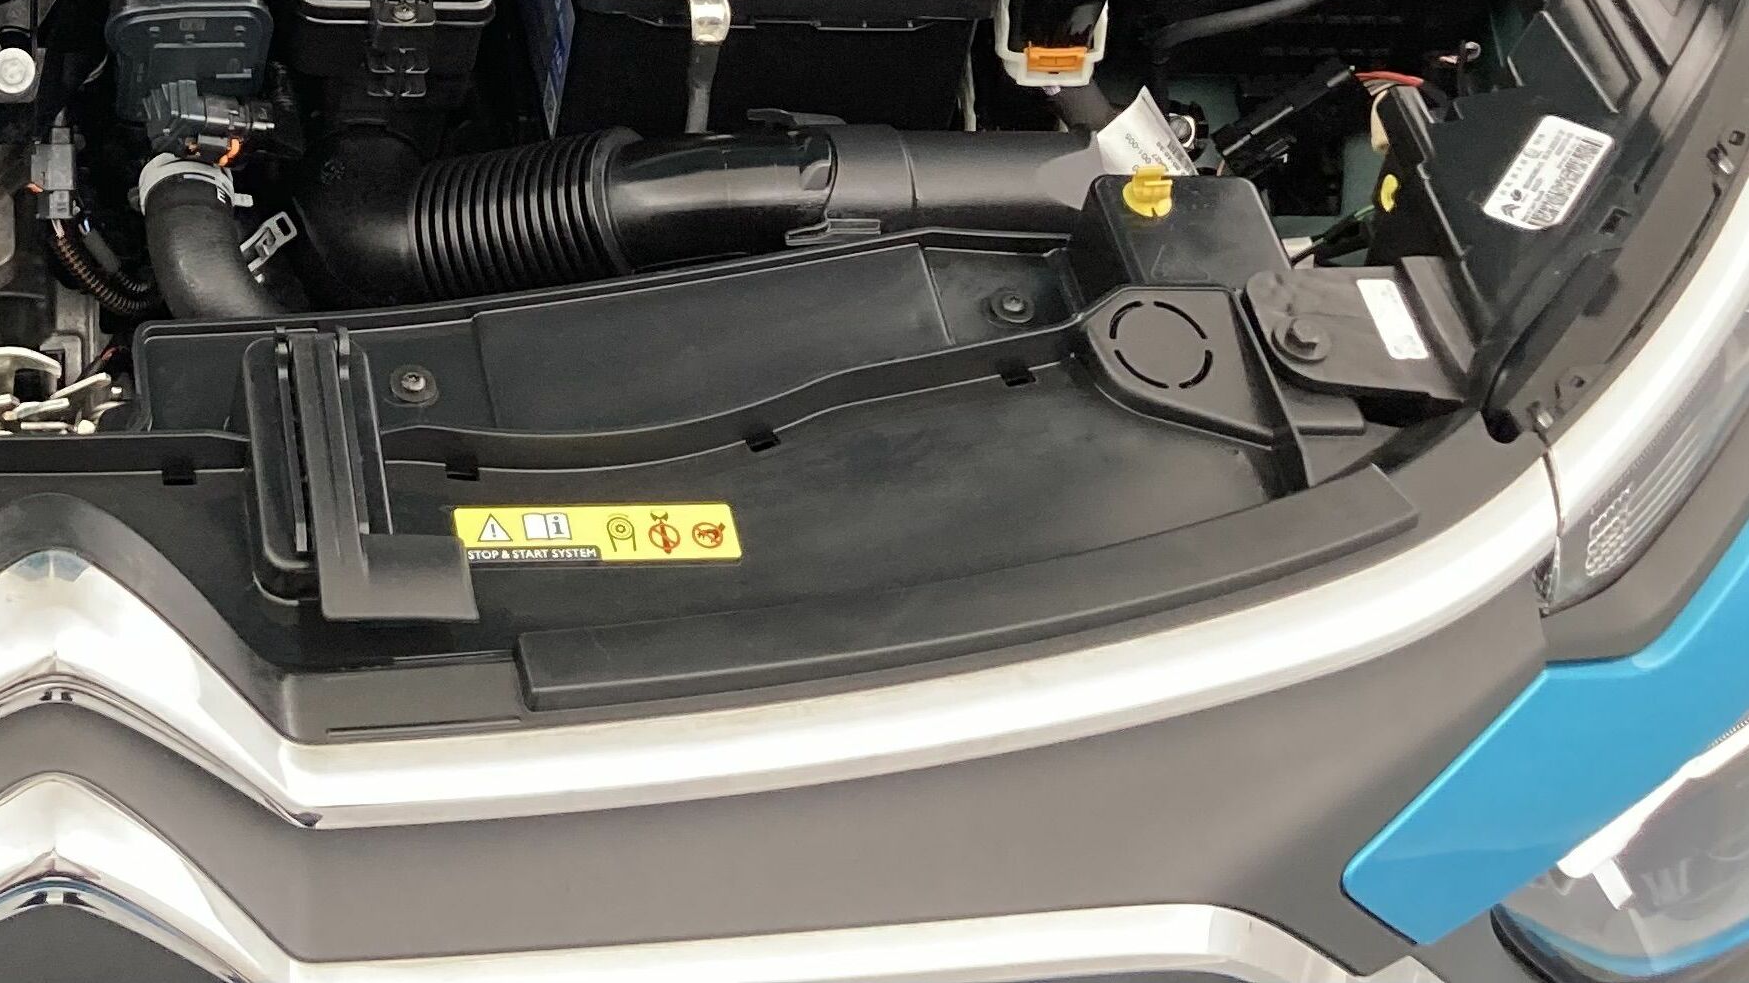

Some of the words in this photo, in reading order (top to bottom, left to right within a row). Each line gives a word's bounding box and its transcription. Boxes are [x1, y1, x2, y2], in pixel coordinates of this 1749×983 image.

[468, 549, 499, 560] STOP
[501, 549, 510, 559] &
[512, 548, 548, 559] START
[551, 547, 597, 558] SYSTEM
